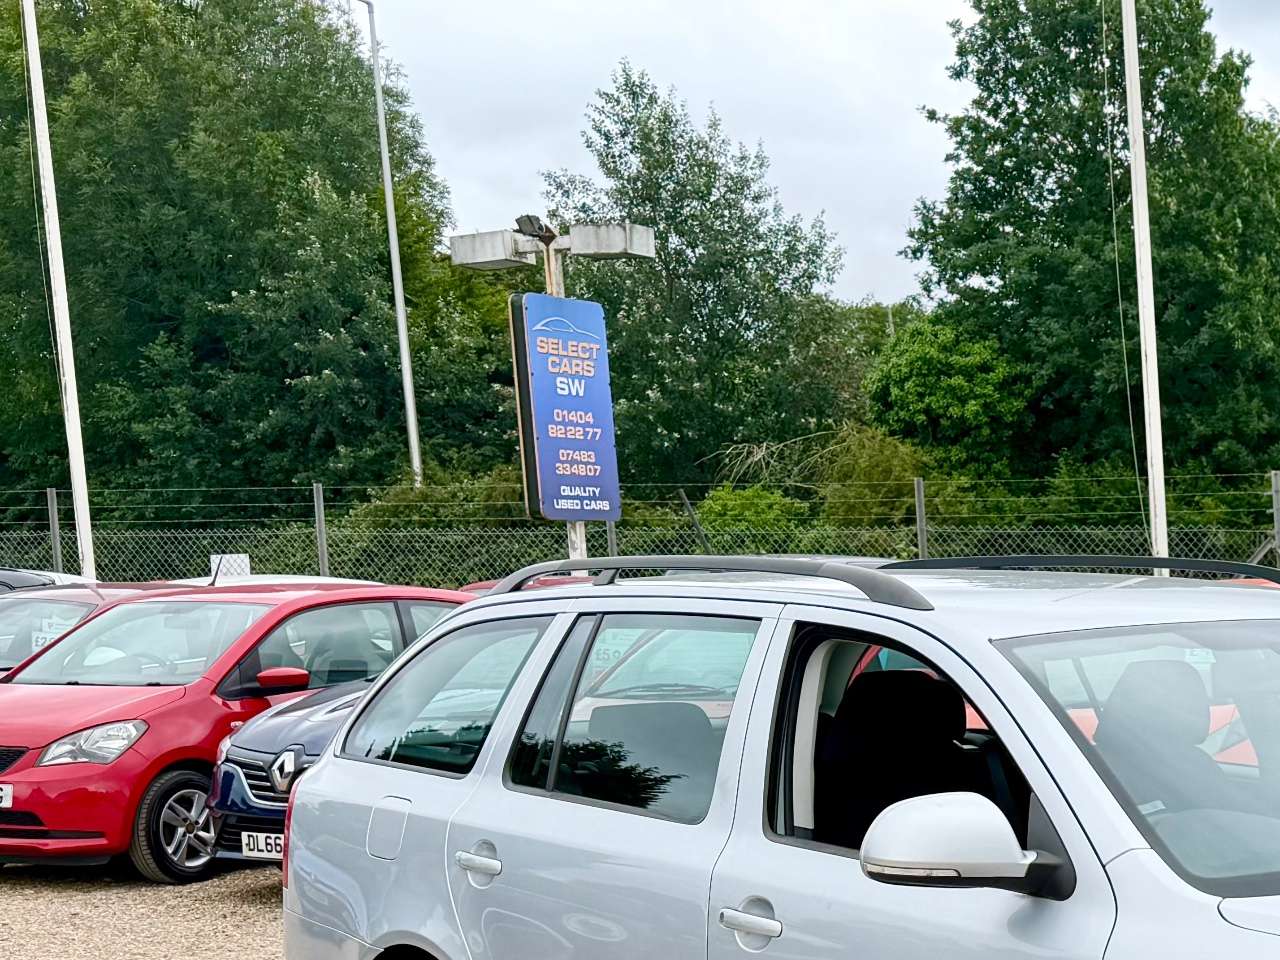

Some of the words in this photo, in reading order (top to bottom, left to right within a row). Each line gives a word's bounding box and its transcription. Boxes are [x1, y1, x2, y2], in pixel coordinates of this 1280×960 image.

[536, 336, 600, 360] SELECT
[547, 356, 595, 378] CARS
[556, 376, 585, 397] SW
[553, 408, 594, 424] 01404
[560, 485, 601, 497] QUALITY
[553, 498, 581, 510] USED
[583, 500, 610, 511] CARS
[247, 834, 283, 854] DL66
